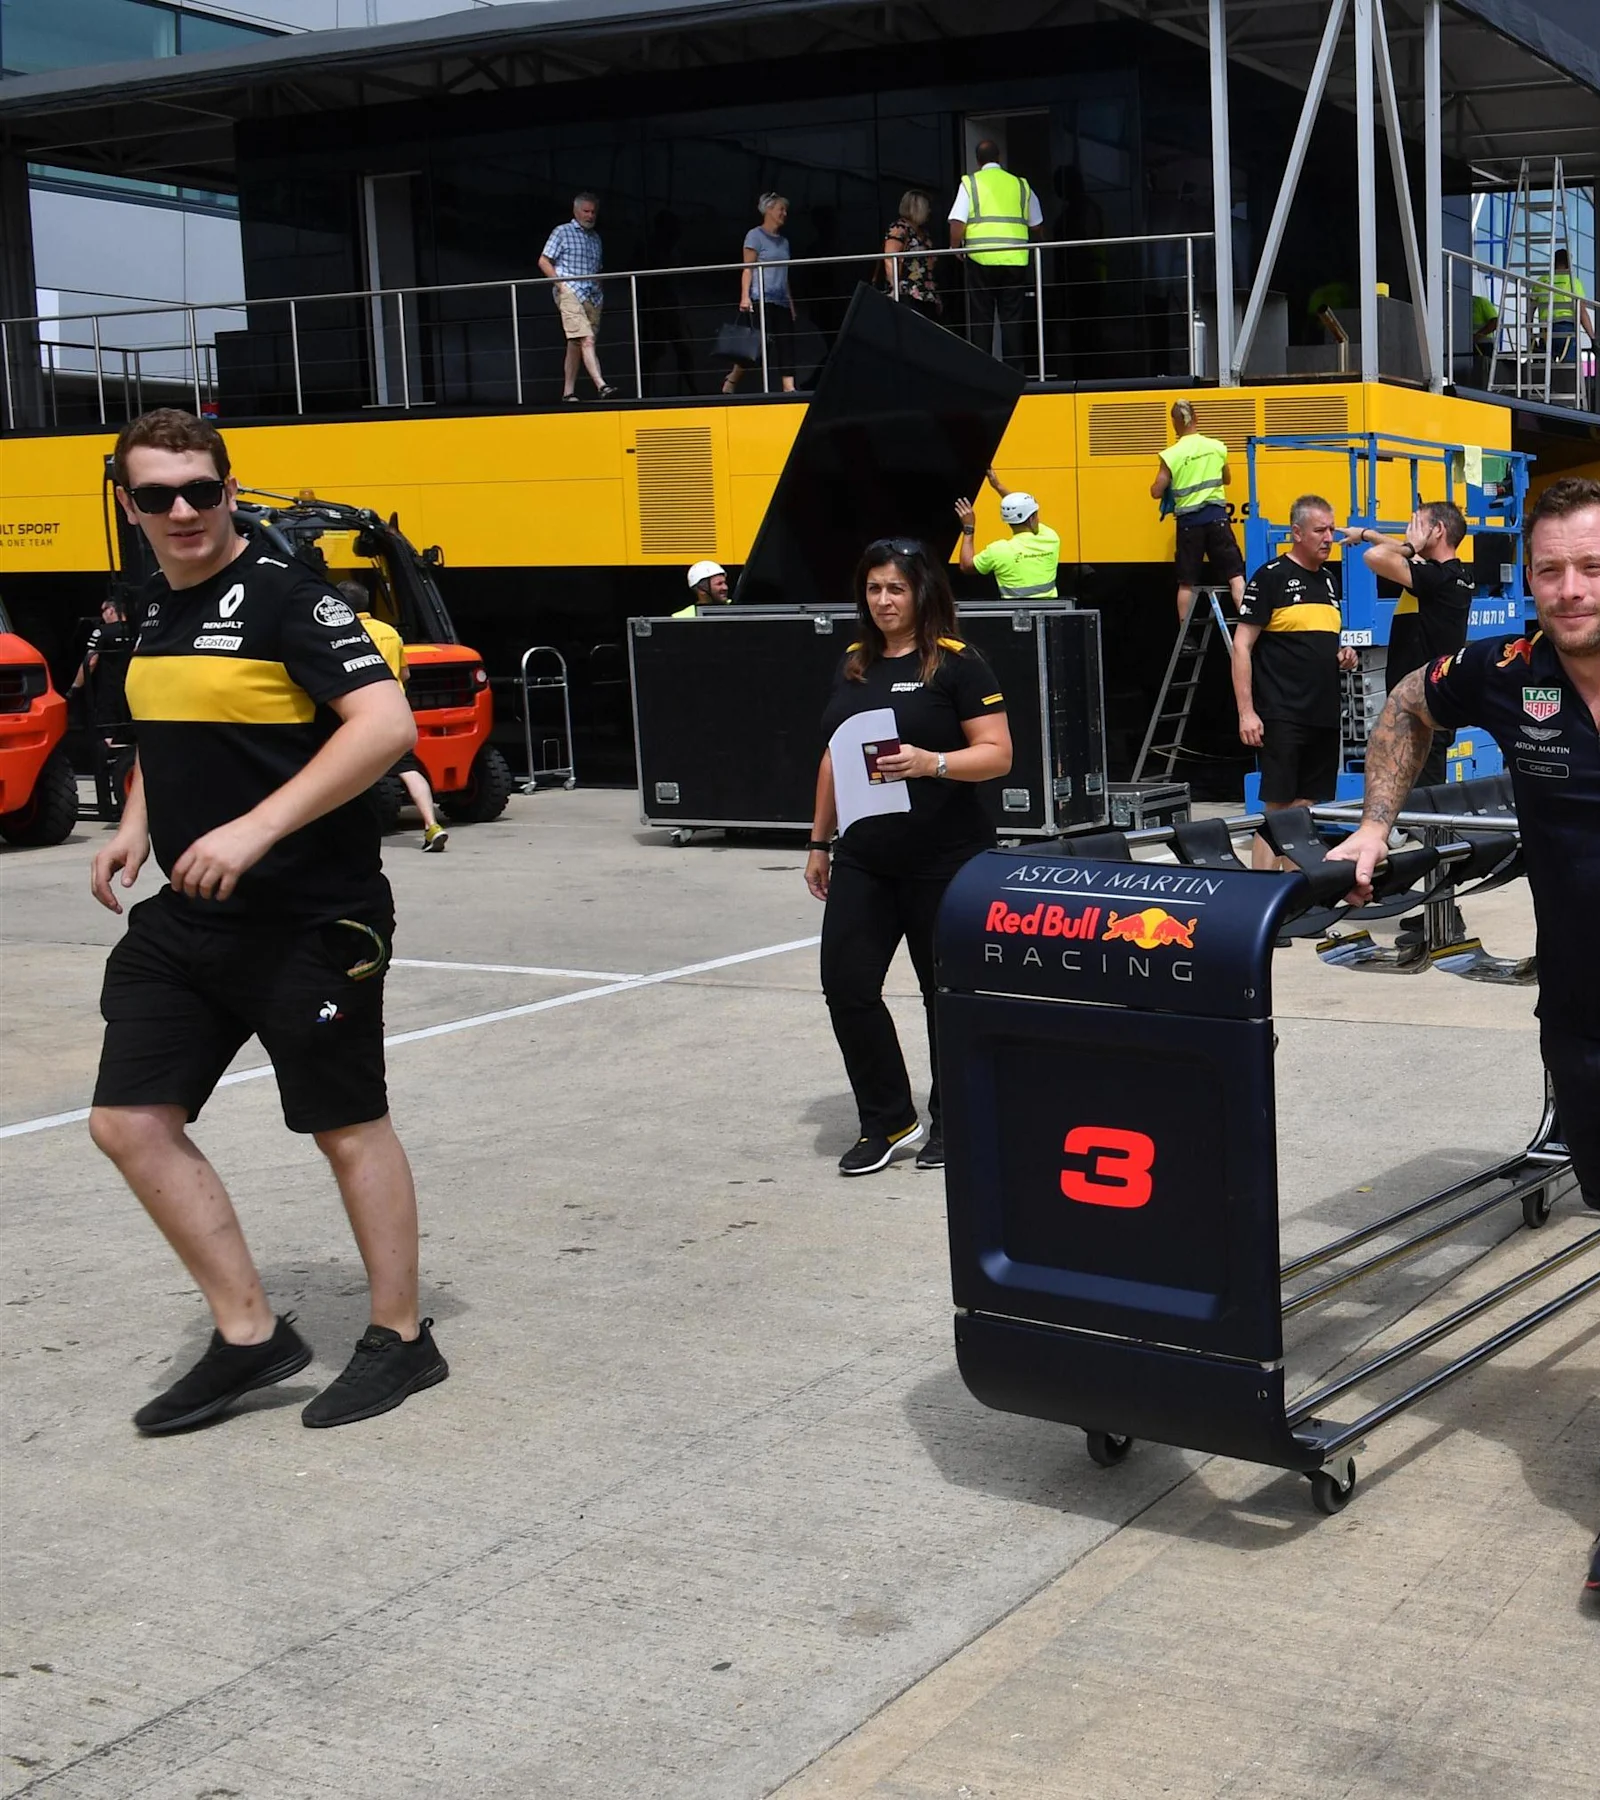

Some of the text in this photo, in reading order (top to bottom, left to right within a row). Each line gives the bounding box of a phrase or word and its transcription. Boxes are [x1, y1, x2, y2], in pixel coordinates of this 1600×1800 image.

[18, 523, 60, 535] SPORT
[29, 538, 53, 547] TEAM
[202, 621, 244, 630] RENAULT
[203, 638, 238, 648] Castrol
[1342, 632, 1370, 644] 4151
[1525, 690, 1558, 701] TAG
[1525, 701, 1559, 719] HEUER
[1514, 741, 1570, 755] ASTON MARTIN
[1006, 864, 1224, 896] ASTON MARTIN
[984, 901, 1101, 941] Red Bull
[984, 943, 1194, 982] RACING
[1061, 1126, 1155, 1208] 3
